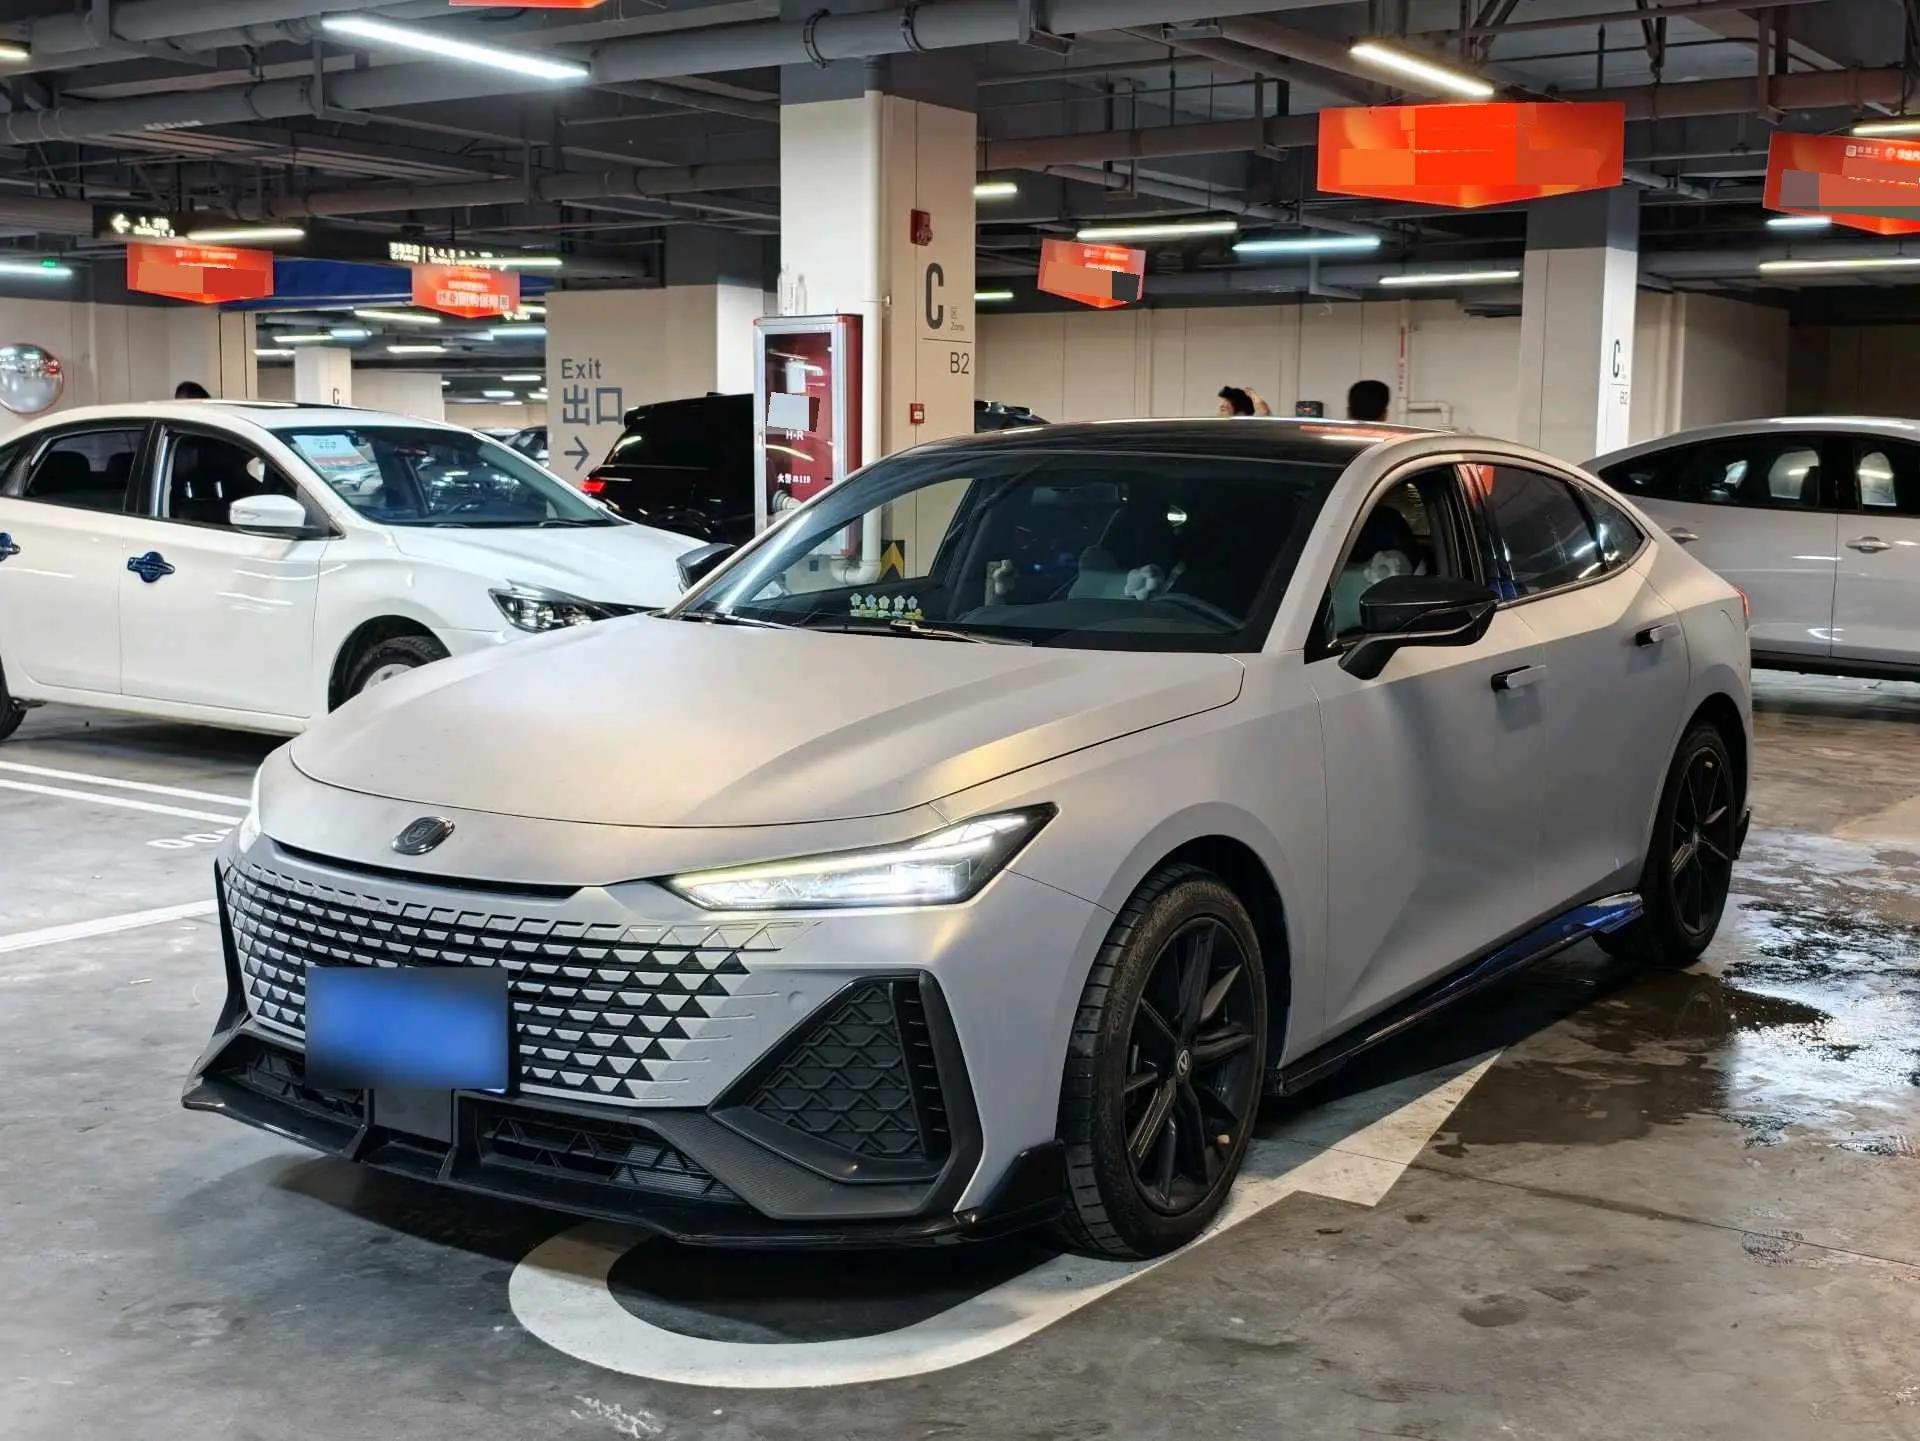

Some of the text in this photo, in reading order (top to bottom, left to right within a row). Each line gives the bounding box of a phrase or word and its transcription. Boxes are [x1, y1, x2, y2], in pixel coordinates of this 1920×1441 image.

[925, 262, 944, 330] C
[561, 358, 602, 379] Exit
[950, 352, 970, 374] B2
[1612, 339, 1621, 378] C
[332, 388, 340, 405] C
[562, 384, 623, 425] 出口
